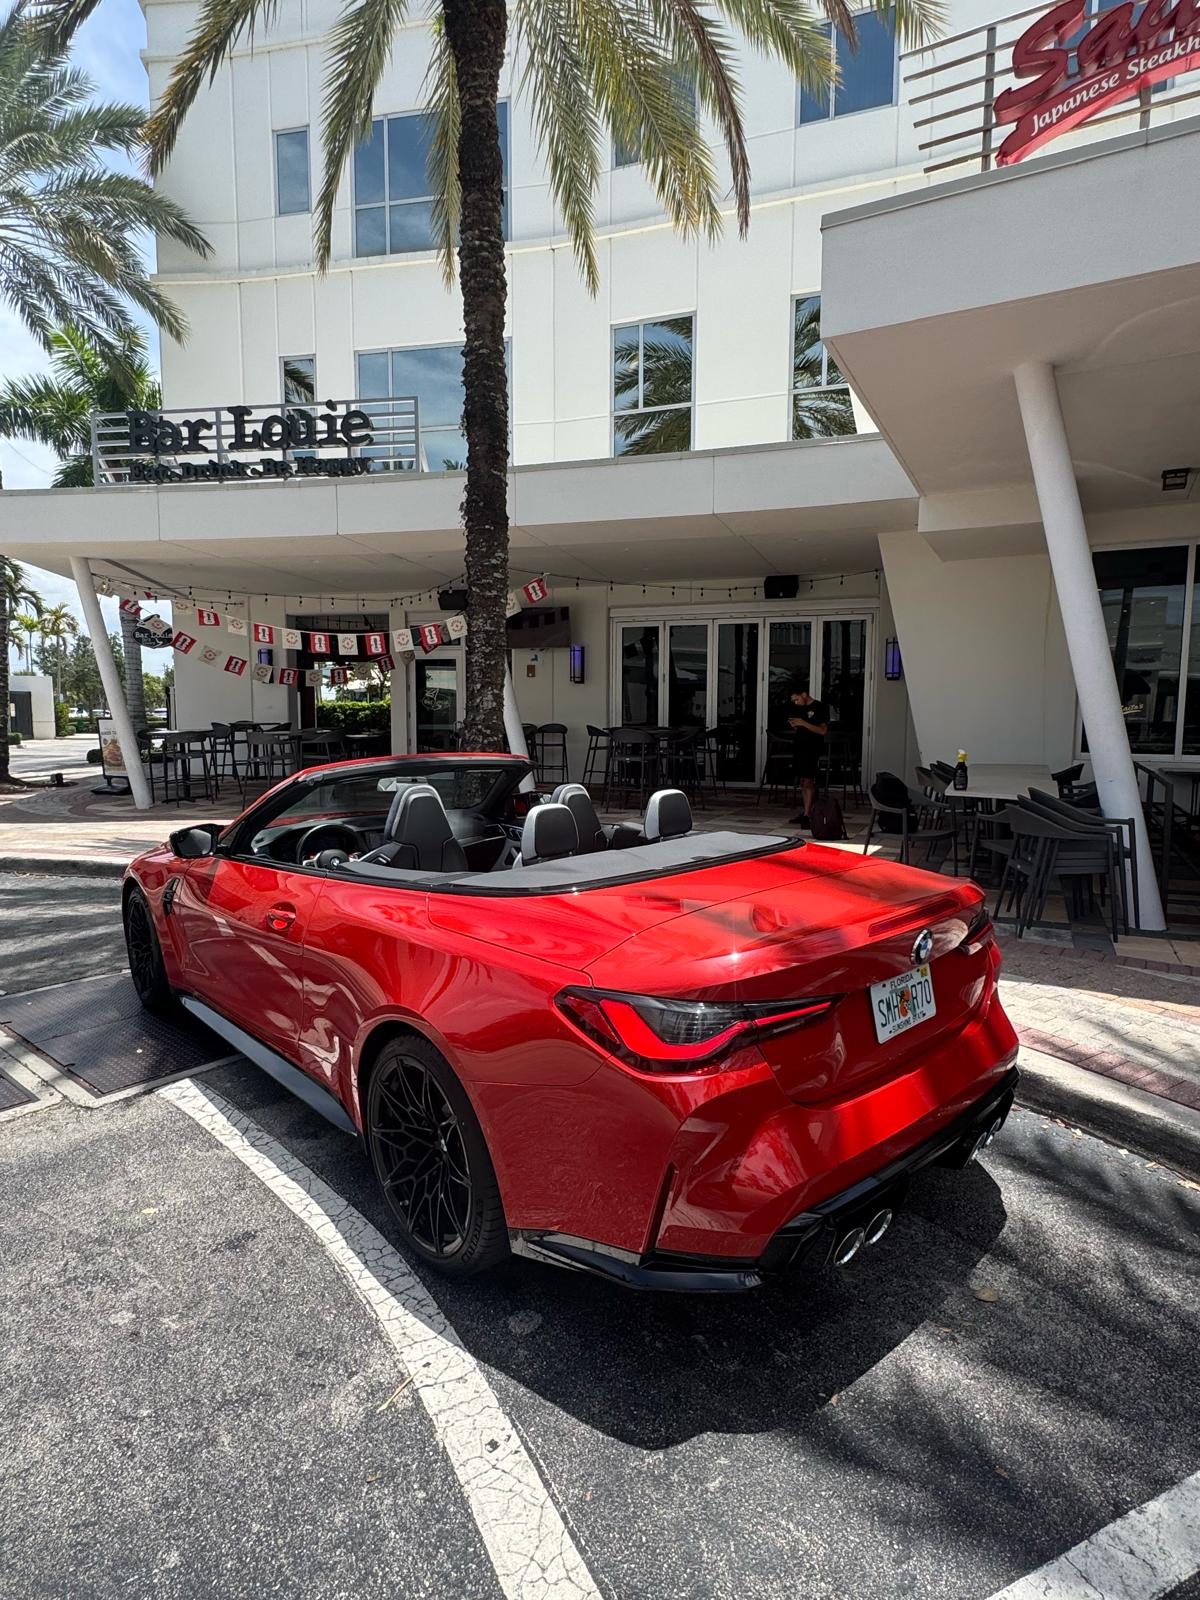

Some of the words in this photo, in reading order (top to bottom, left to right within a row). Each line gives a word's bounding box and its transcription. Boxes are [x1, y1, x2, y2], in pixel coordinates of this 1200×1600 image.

[1031, 72, 1119, 136] Japanese
[125, 411, 213, 453] Bar
[226, 399, 374, 451] Louie
[294, 456, 370, 477] Happy
[890, 973, 914, 990] FLORIDA
[892, 1017, 912, 1034] SUNSHINE
